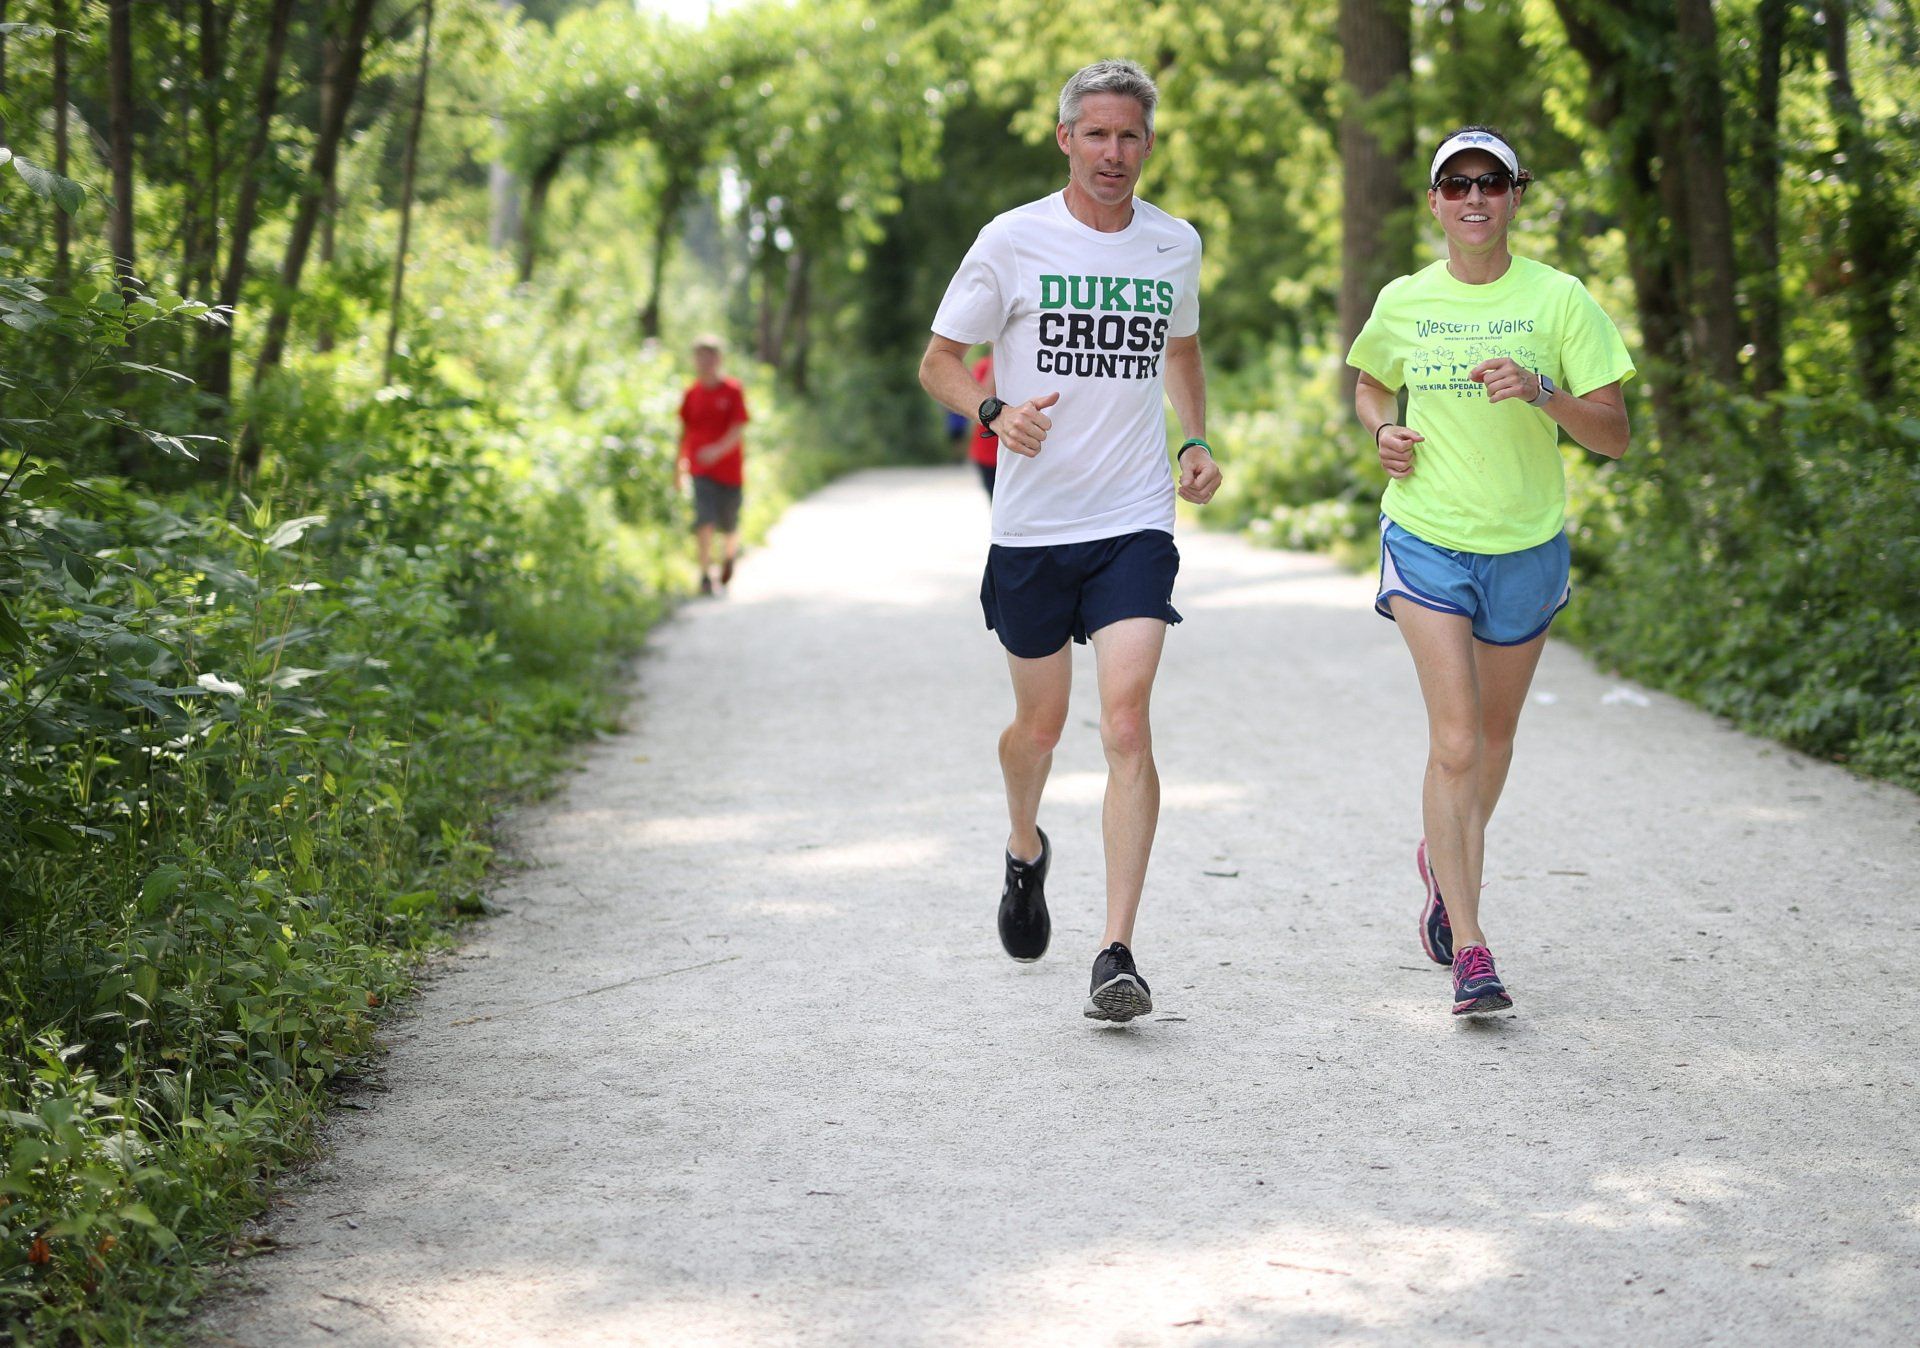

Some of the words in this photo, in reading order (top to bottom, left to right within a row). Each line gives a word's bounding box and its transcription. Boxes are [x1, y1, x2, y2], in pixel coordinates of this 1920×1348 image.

[1039, 275, 1173, 316] DUKES
[1039, 313, 1169, 353] CROSS
[1416, 319, 1480, 337] Western
[1489, 320, 1534, 334] Walks
[1037, 349, 1160, 379] COUNTRY
